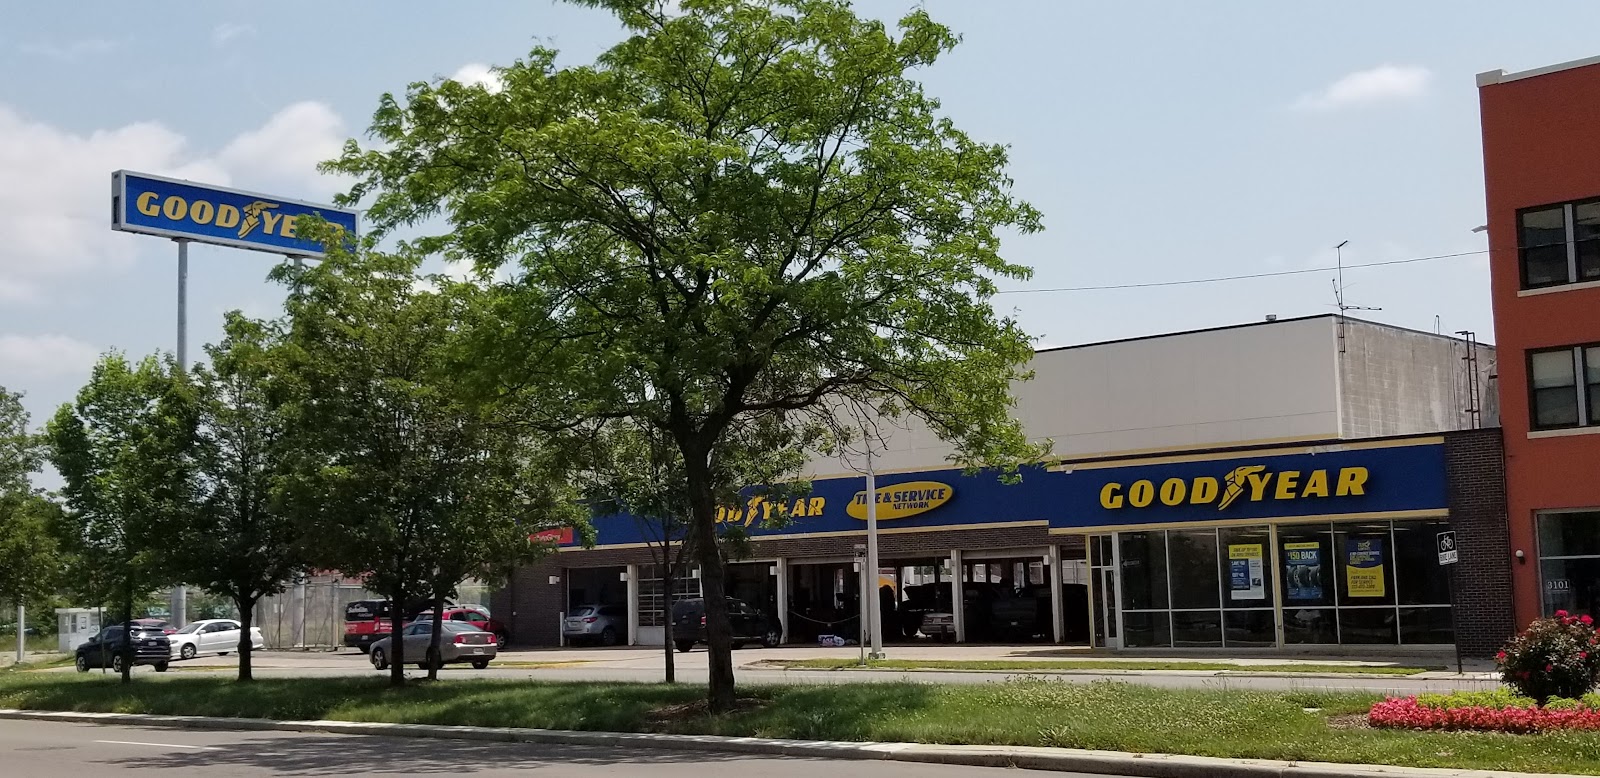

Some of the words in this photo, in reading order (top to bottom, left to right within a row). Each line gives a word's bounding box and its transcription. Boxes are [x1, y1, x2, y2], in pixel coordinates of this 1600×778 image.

[136, 191, 346, 242] GOODYER
[856, 493, 881, 505] TIE
[883, 492, 892, 503] &
[894, 488, 946, 502] SERVICE
[892, 501, 929, 510] NETWORK
[1287, 551, 1300, 560] $150
[1301, 550, 1317, 559] BACK
[1448, 552, 1457, 560] LANE
[1547, 580, 1569, 590] 3101
